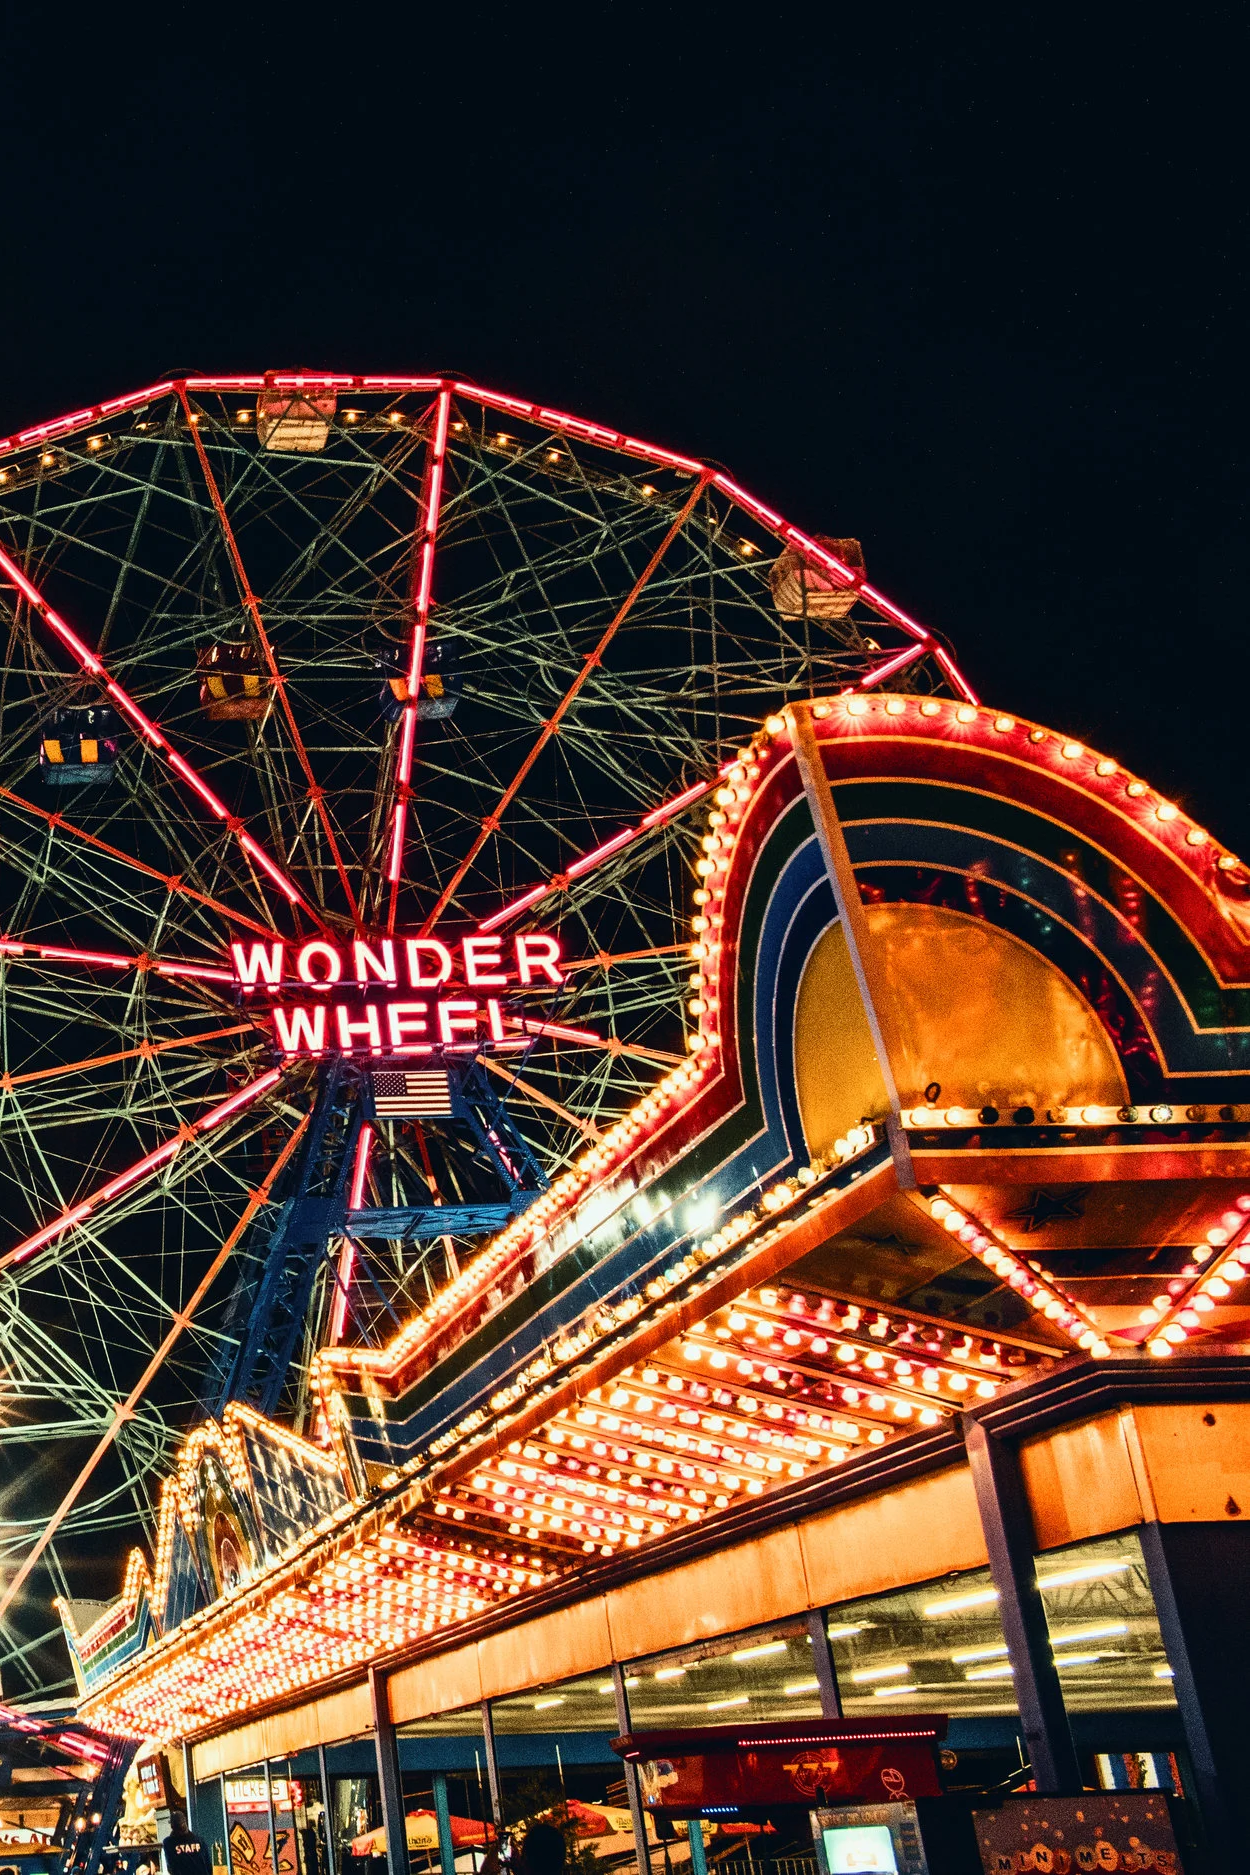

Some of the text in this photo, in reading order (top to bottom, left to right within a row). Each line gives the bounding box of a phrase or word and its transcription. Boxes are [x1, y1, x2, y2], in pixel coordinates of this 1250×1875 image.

[231, 935, 570, 993] WONDER
[273, 999, 532, 1057] WHEEL
[231, 1781, 280, 1798] TICKES
[175, 1843, 201, 1855] STAFF
[998, 1849, 1169, 1870] MINI MELTS
